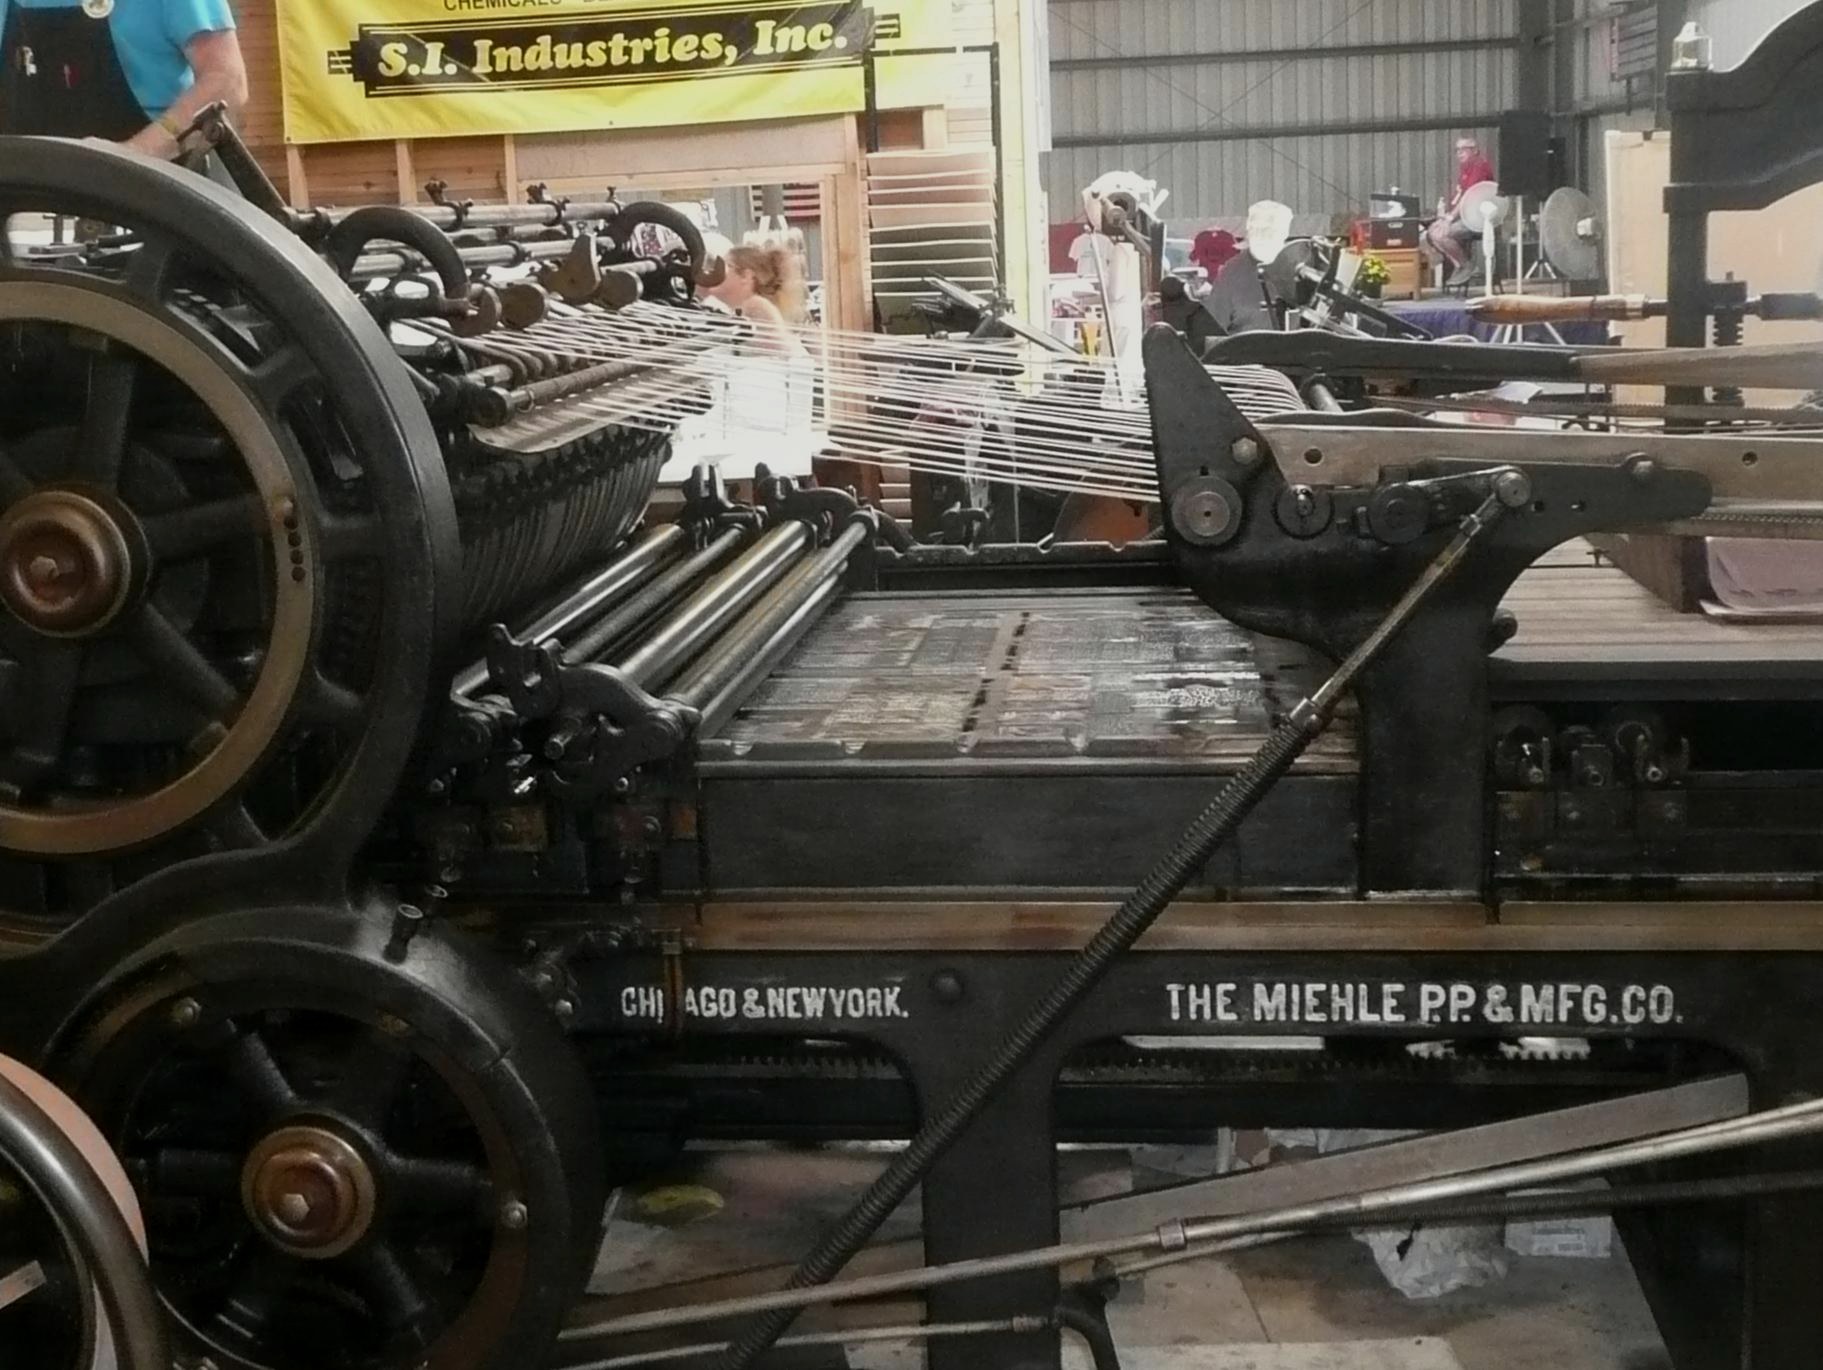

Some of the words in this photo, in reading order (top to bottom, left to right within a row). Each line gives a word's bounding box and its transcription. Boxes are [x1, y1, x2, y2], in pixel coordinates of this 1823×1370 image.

[444, 0, 562, 11] CHEMI
[378, 42, 458, 77] S.I.
[472, 27, 738, 74] Industries,
[753, 19, 847, 55] Inc.
[621, 987, 737, 1019] CHIAGO
[1166, 983, 1238, 1022] THE
[1253, 983, 1406, 1023] MIEHLE
[1483, 984, 1514, 1023] &
